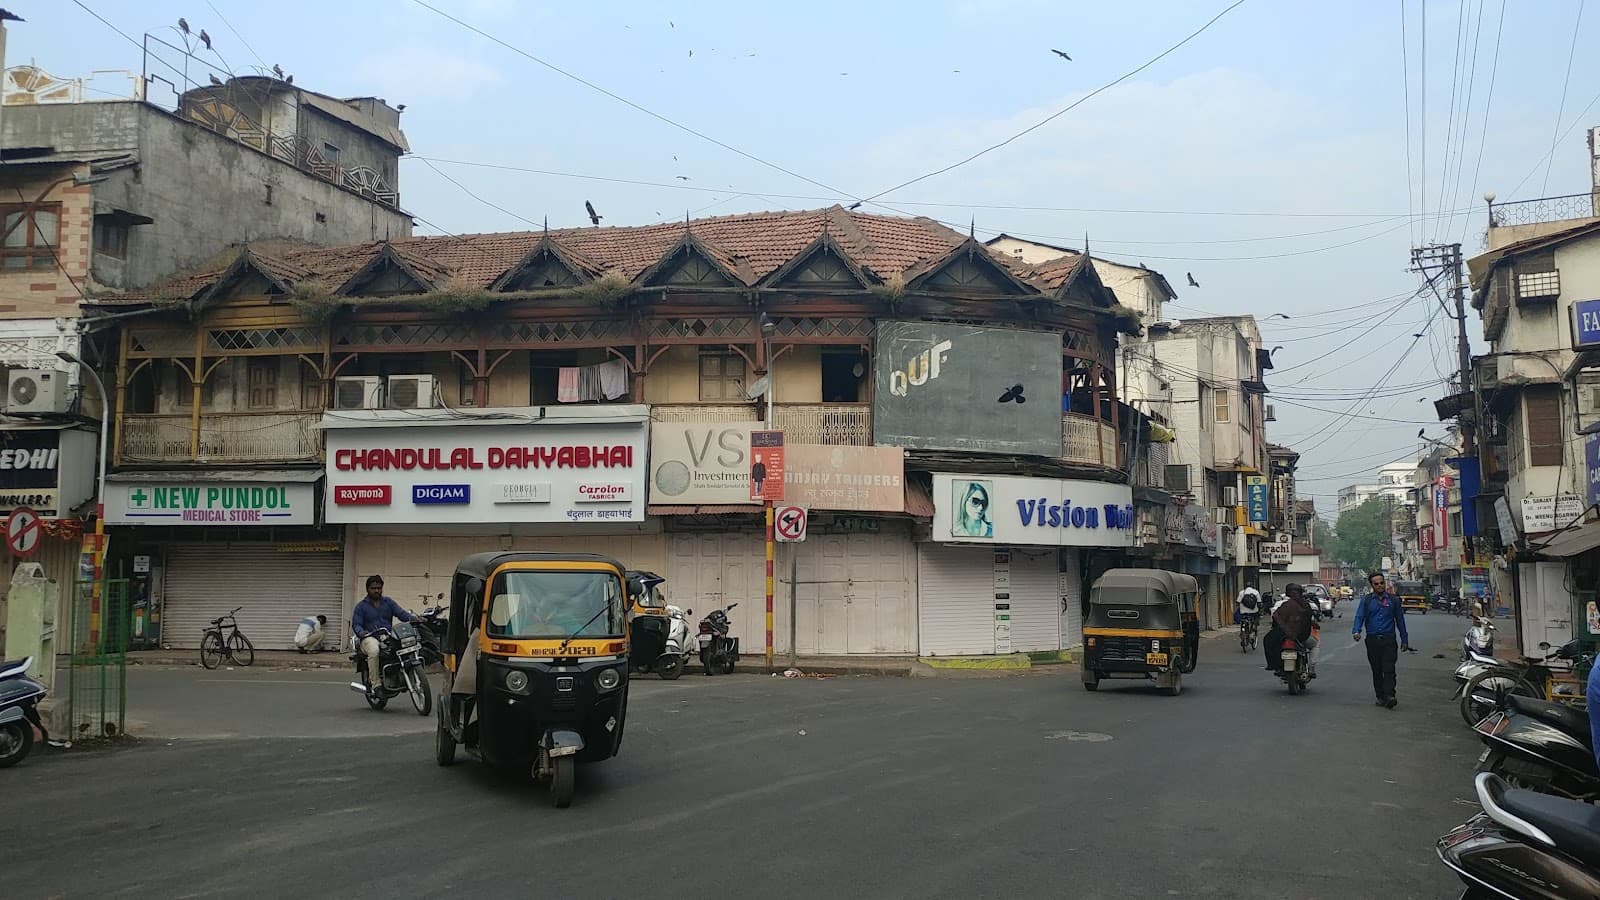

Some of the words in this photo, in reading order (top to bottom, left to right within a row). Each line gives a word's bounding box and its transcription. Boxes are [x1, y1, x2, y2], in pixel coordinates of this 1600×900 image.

[1582, 311, 1600, 332] FA
[335, 447, 484, 471] CHANDULAL
[488, 445, 633, 469] DAHYABHAI
[684, 428, 745, 469] VS
[154, 487, 201, 509] NEW
[207, 486, 291, 509] PUNDOL
[416, 487, 465, 500] DIGJAM
[183, 510, 227, 522] MEDICAL
[229, 509, 261, 522] STORE
[1015, 497, 1099, 529] Vision
[559, 647, 596, 655] 2028
